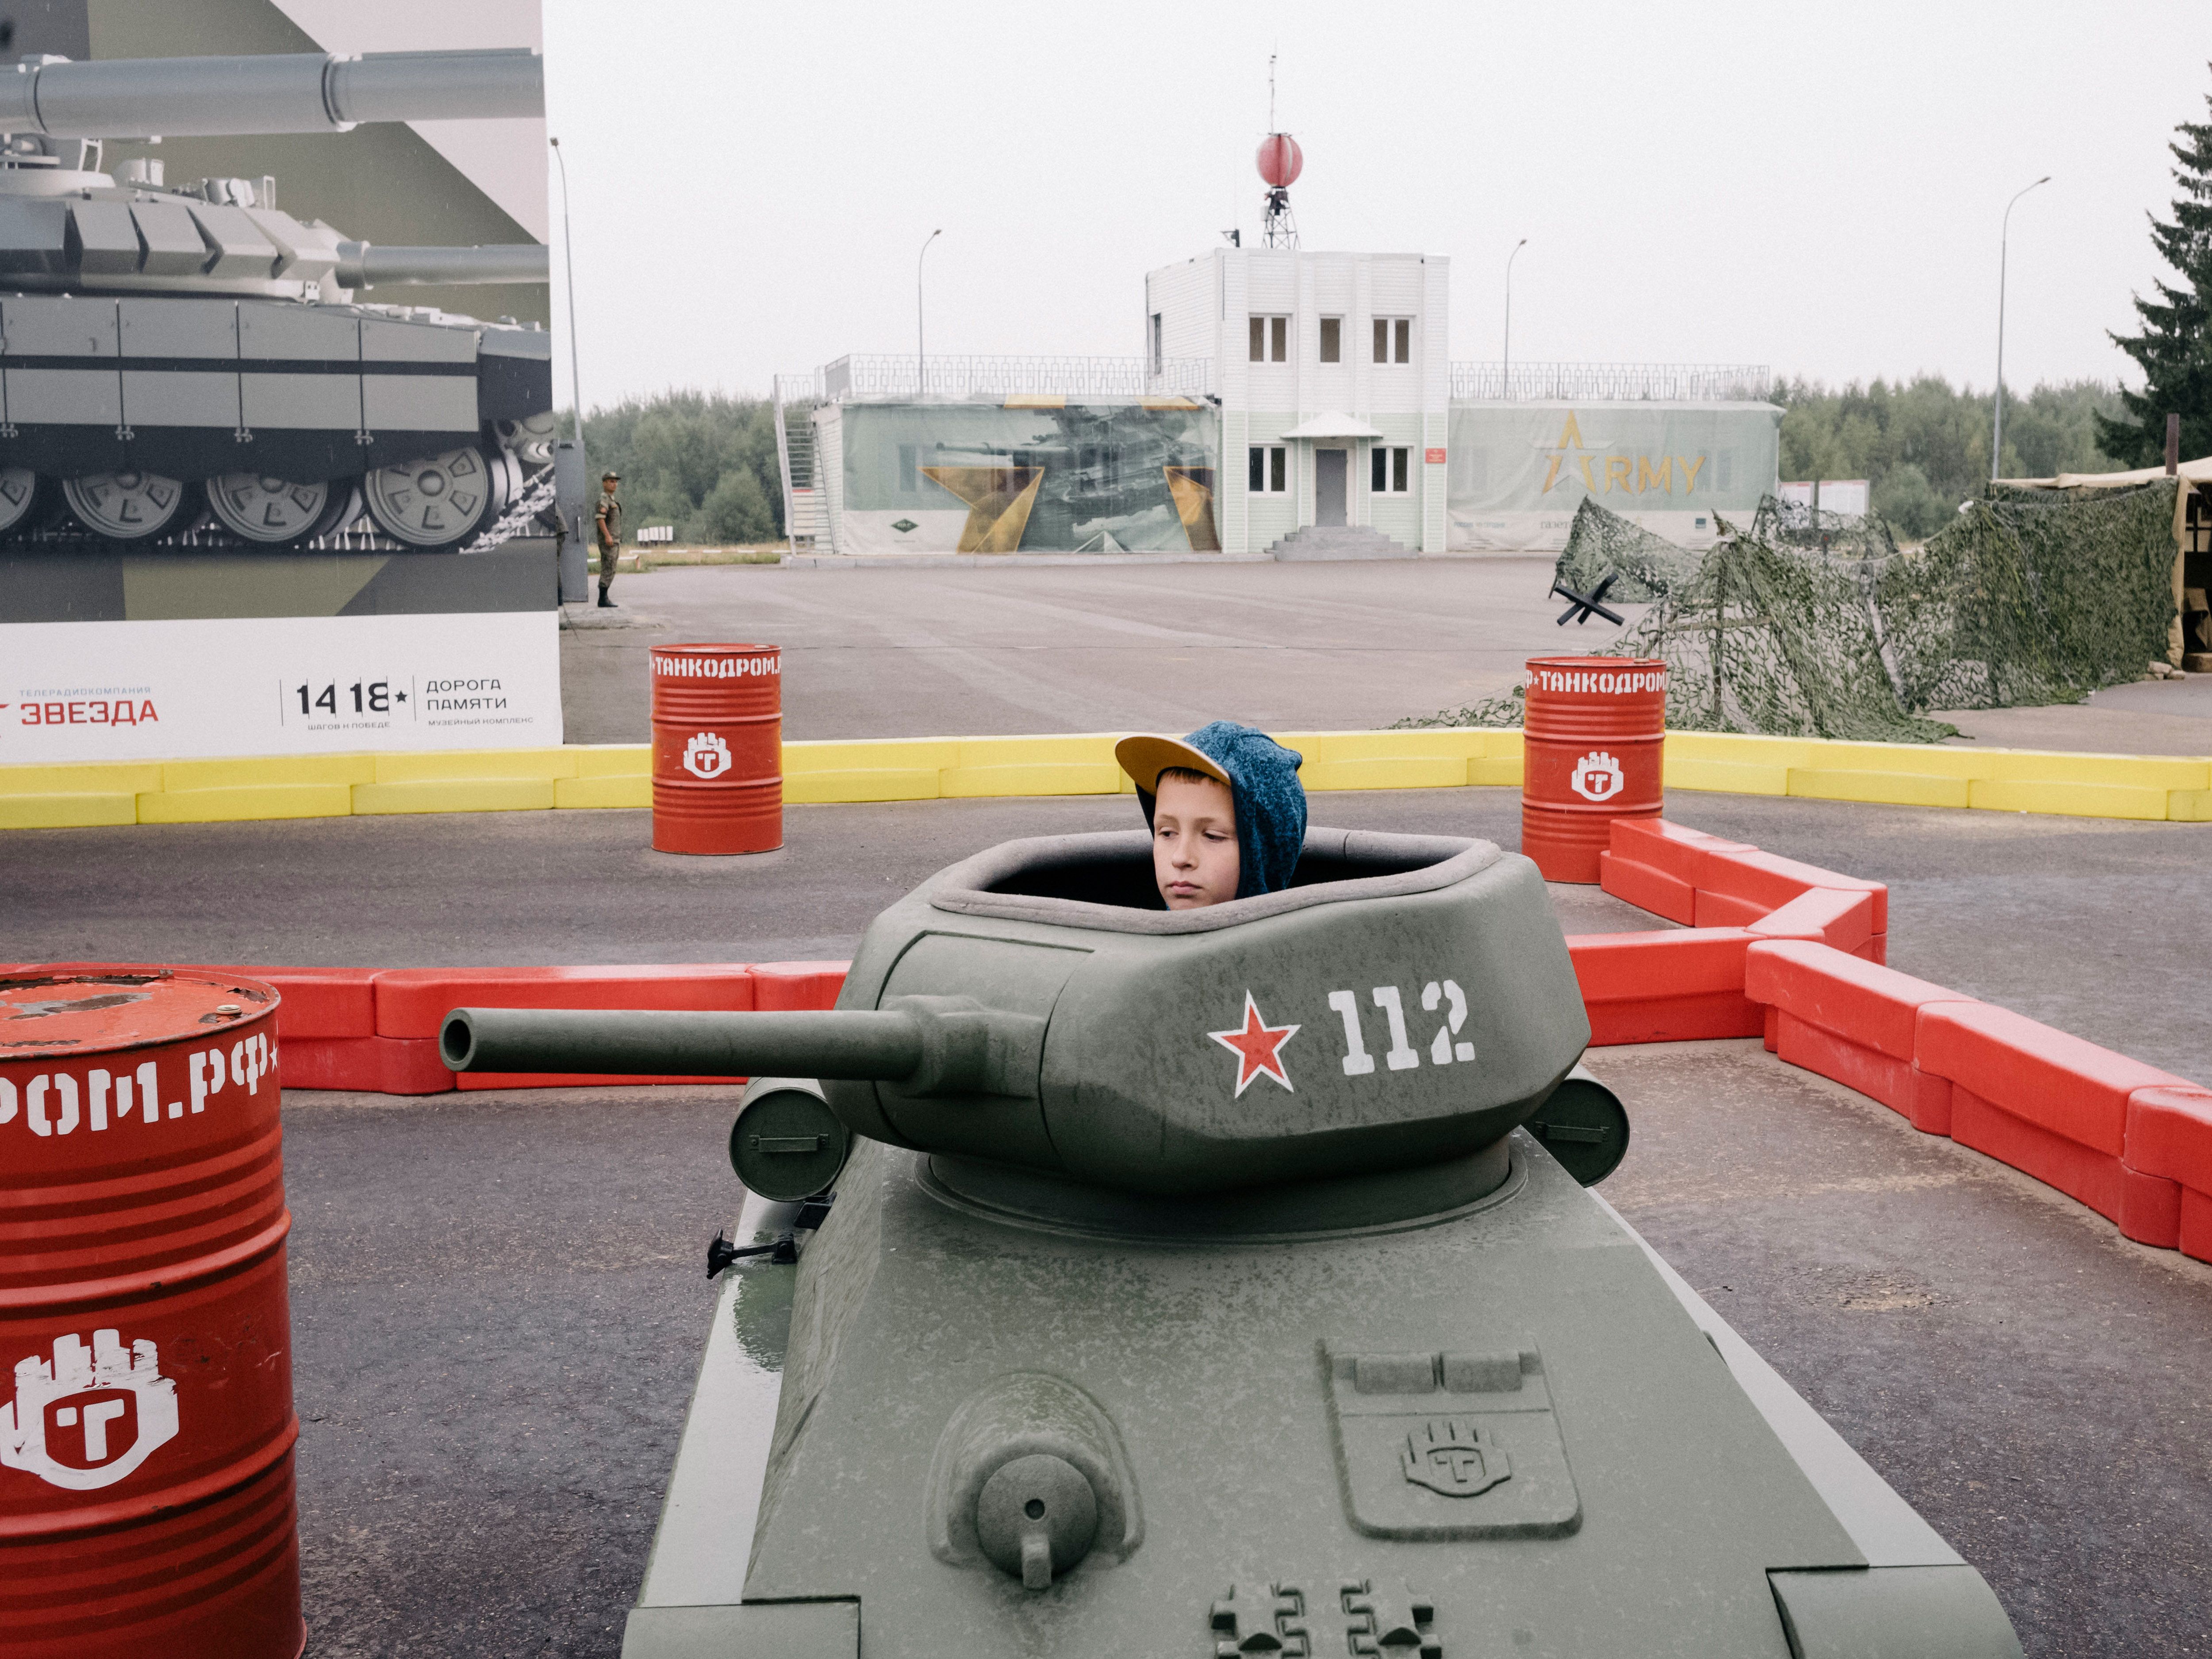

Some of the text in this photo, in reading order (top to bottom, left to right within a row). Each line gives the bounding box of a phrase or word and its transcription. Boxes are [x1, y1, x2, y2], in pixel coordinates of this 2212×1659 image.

[1542, 410, 1707, 495] ARMY
[19, 687, 151, 697] ТЕЛЕРАДИОКОМПАНИЯ
[426, 679, 501, 693] ДОРОГА
[20, 700, 159, 726] ЗВЕЗДА
[427, 698, 507, 710] ПАМЯТИ
[1328, 979, 1475, 1075] 112
